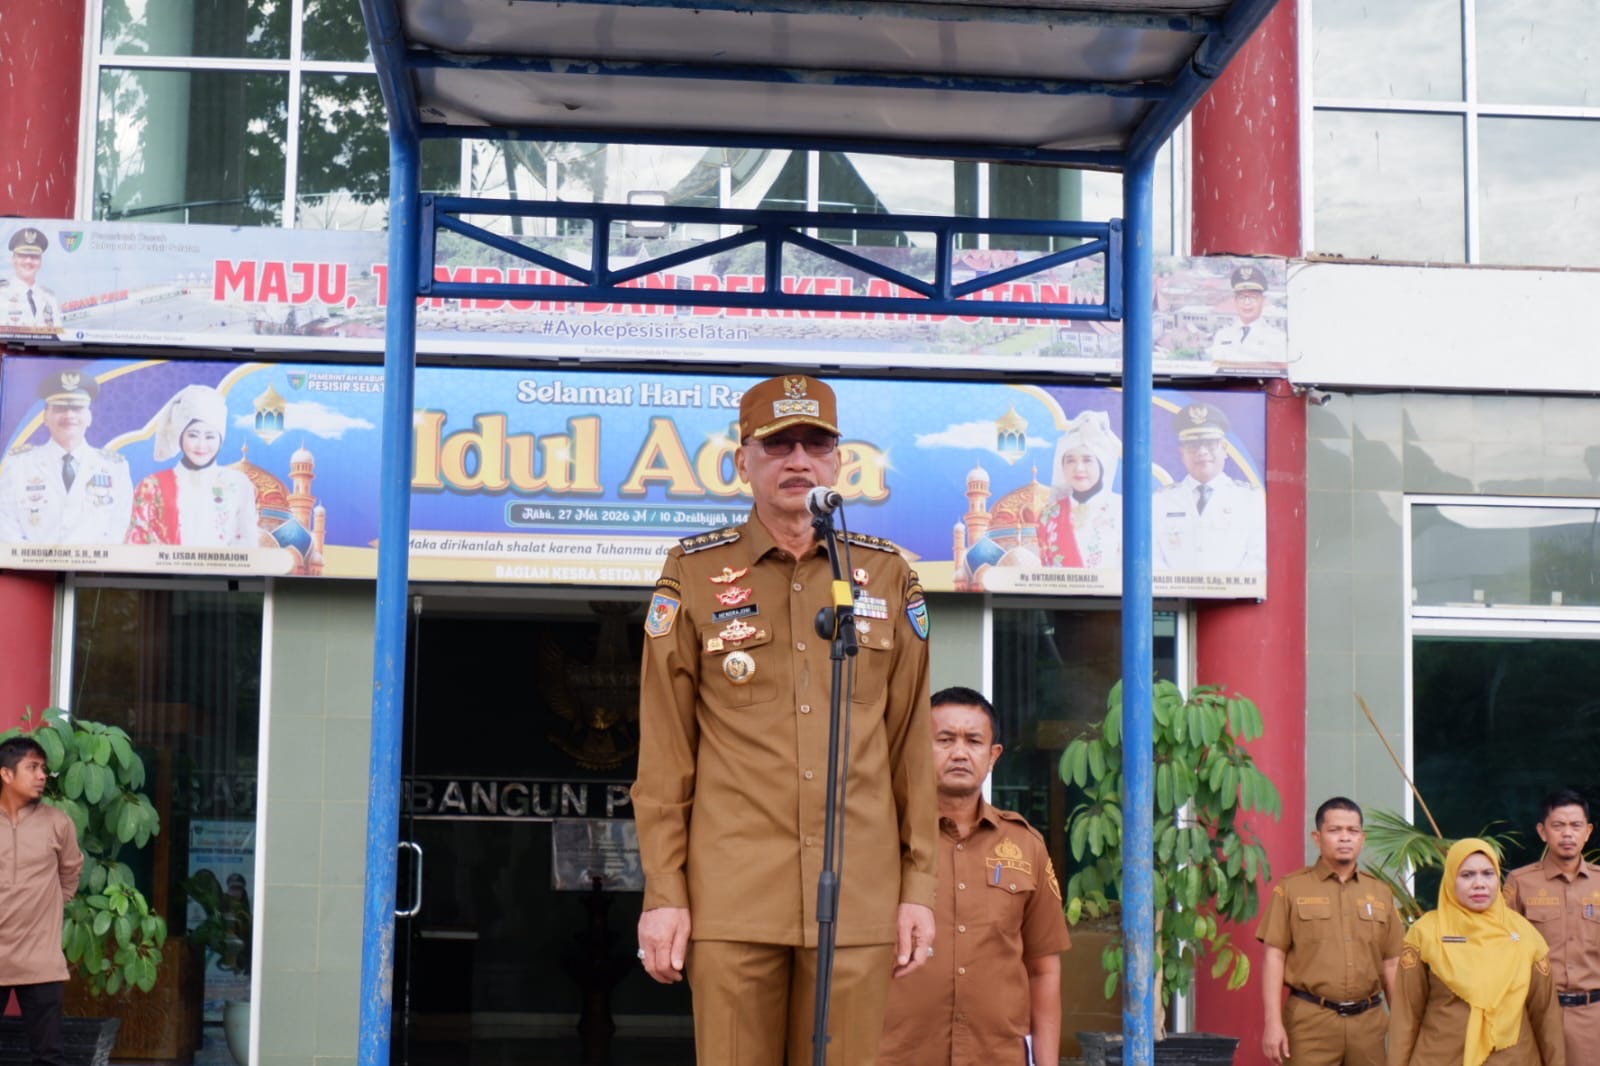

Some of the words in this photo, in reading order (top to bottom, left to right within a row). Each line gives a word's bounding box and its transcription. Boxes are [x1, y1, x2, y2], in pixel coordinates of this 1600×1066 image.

[213, 259, 357, 309] MAJU,
[543, 319, 749, 341] #Ayokepesisirselatan
[308, 381, 349, 392] PESISIR
[516, 379, 633, 405] Selamat
[639, 382, 701, 407] Hari
[410, 409, 603, 494] Idul
[623, 418, 889, 499] Ada
[558, 509, 572, 520] 27
[574, 507, 598, 521] Mei
[601, 510, 630, 521] 2026
[649, 511, 657, 521] /
[660, 511, 671, 521] 10
[198, 552, 249, 562] HENDRAJONI
[440, 538, 503, 551] dirikanlah
[506, 541, 545, 553] shalat
[549, 542, 592, 554] karena
[596, 543, 652, 556] Tuhanmu
